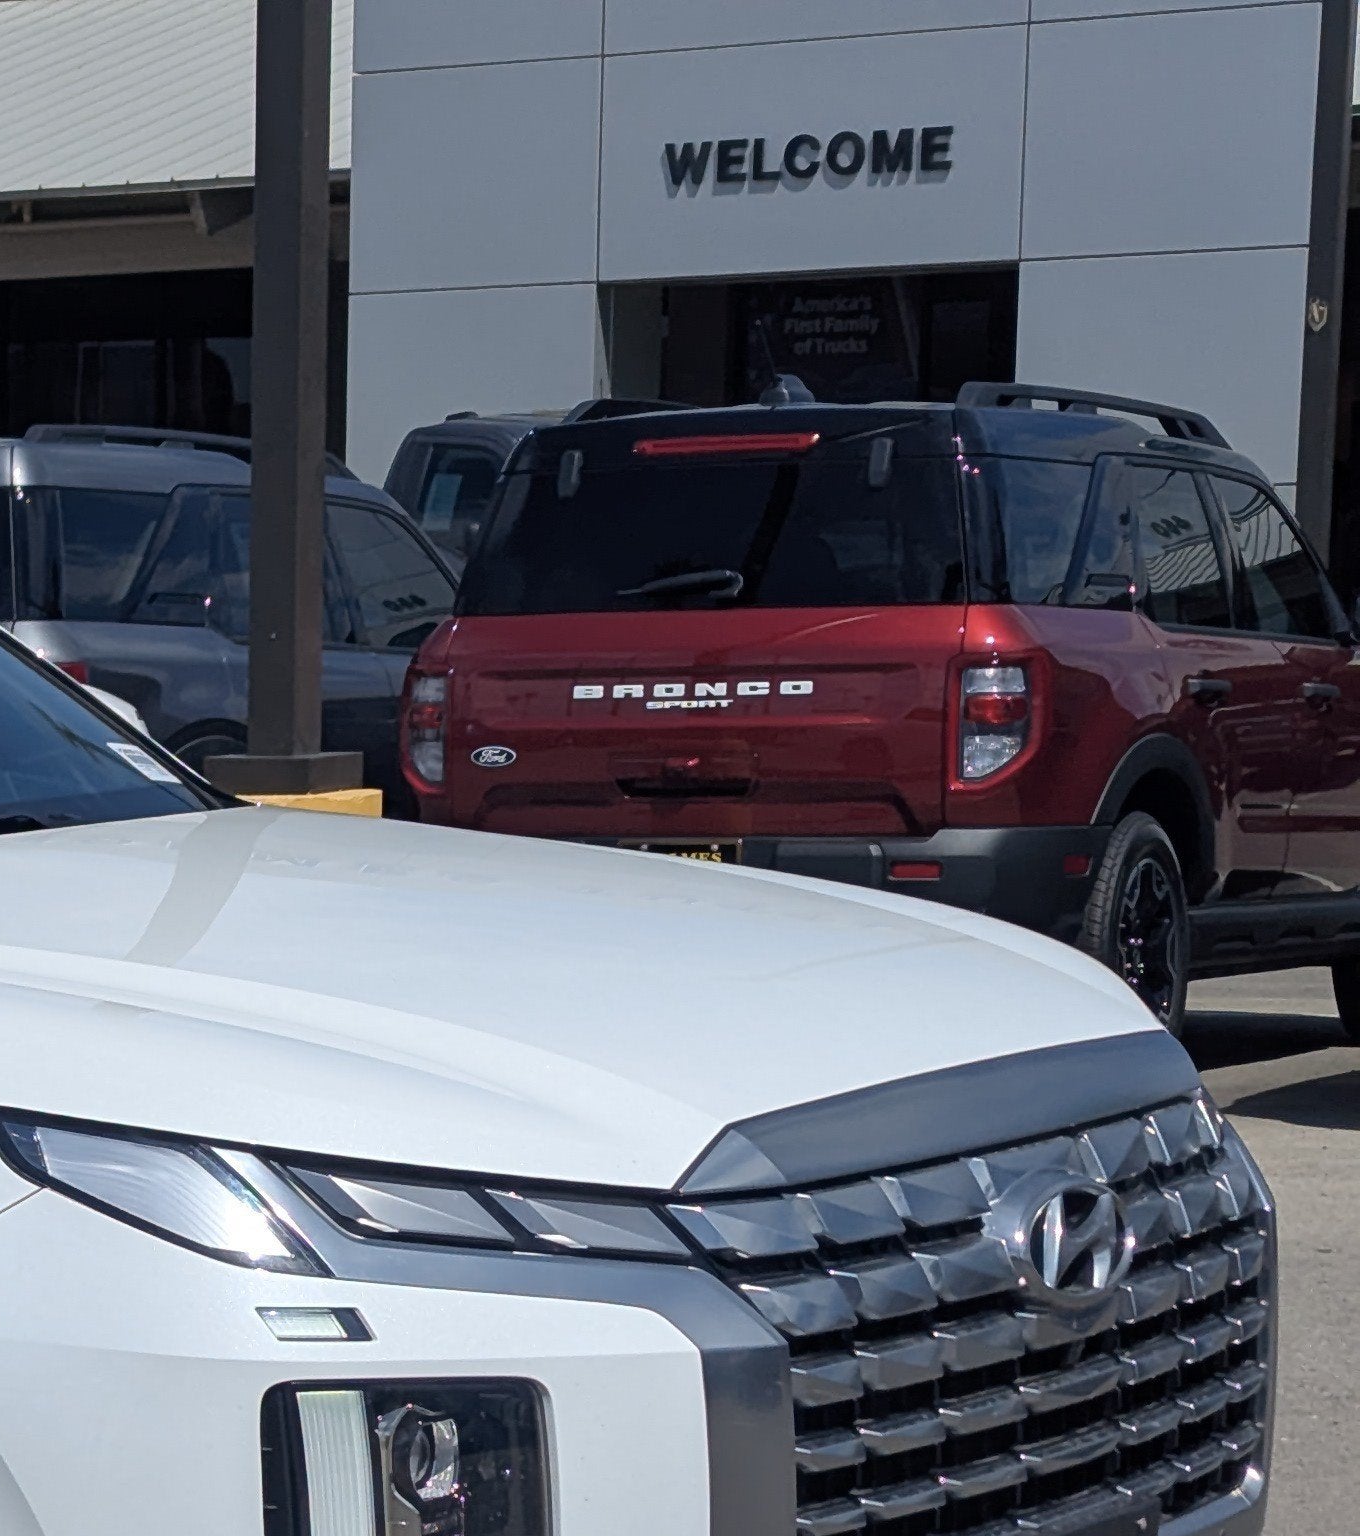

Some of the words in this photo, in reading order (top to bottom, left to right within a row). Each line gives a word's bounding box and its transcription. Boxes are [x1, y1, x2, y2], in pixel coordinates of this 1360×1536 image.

[664, 126, 954, 186] WELCOME
[784, 316, 822, 334] First
[824, 315, 879, 335] Family
[792, 336, 812, 354] of
[814, 334, 868, 354] Trucks
[572, 680, 813, 700] BRONCO
[646, 699, 734, 710] SPORT
[477, 748, 510, 766] Ford
